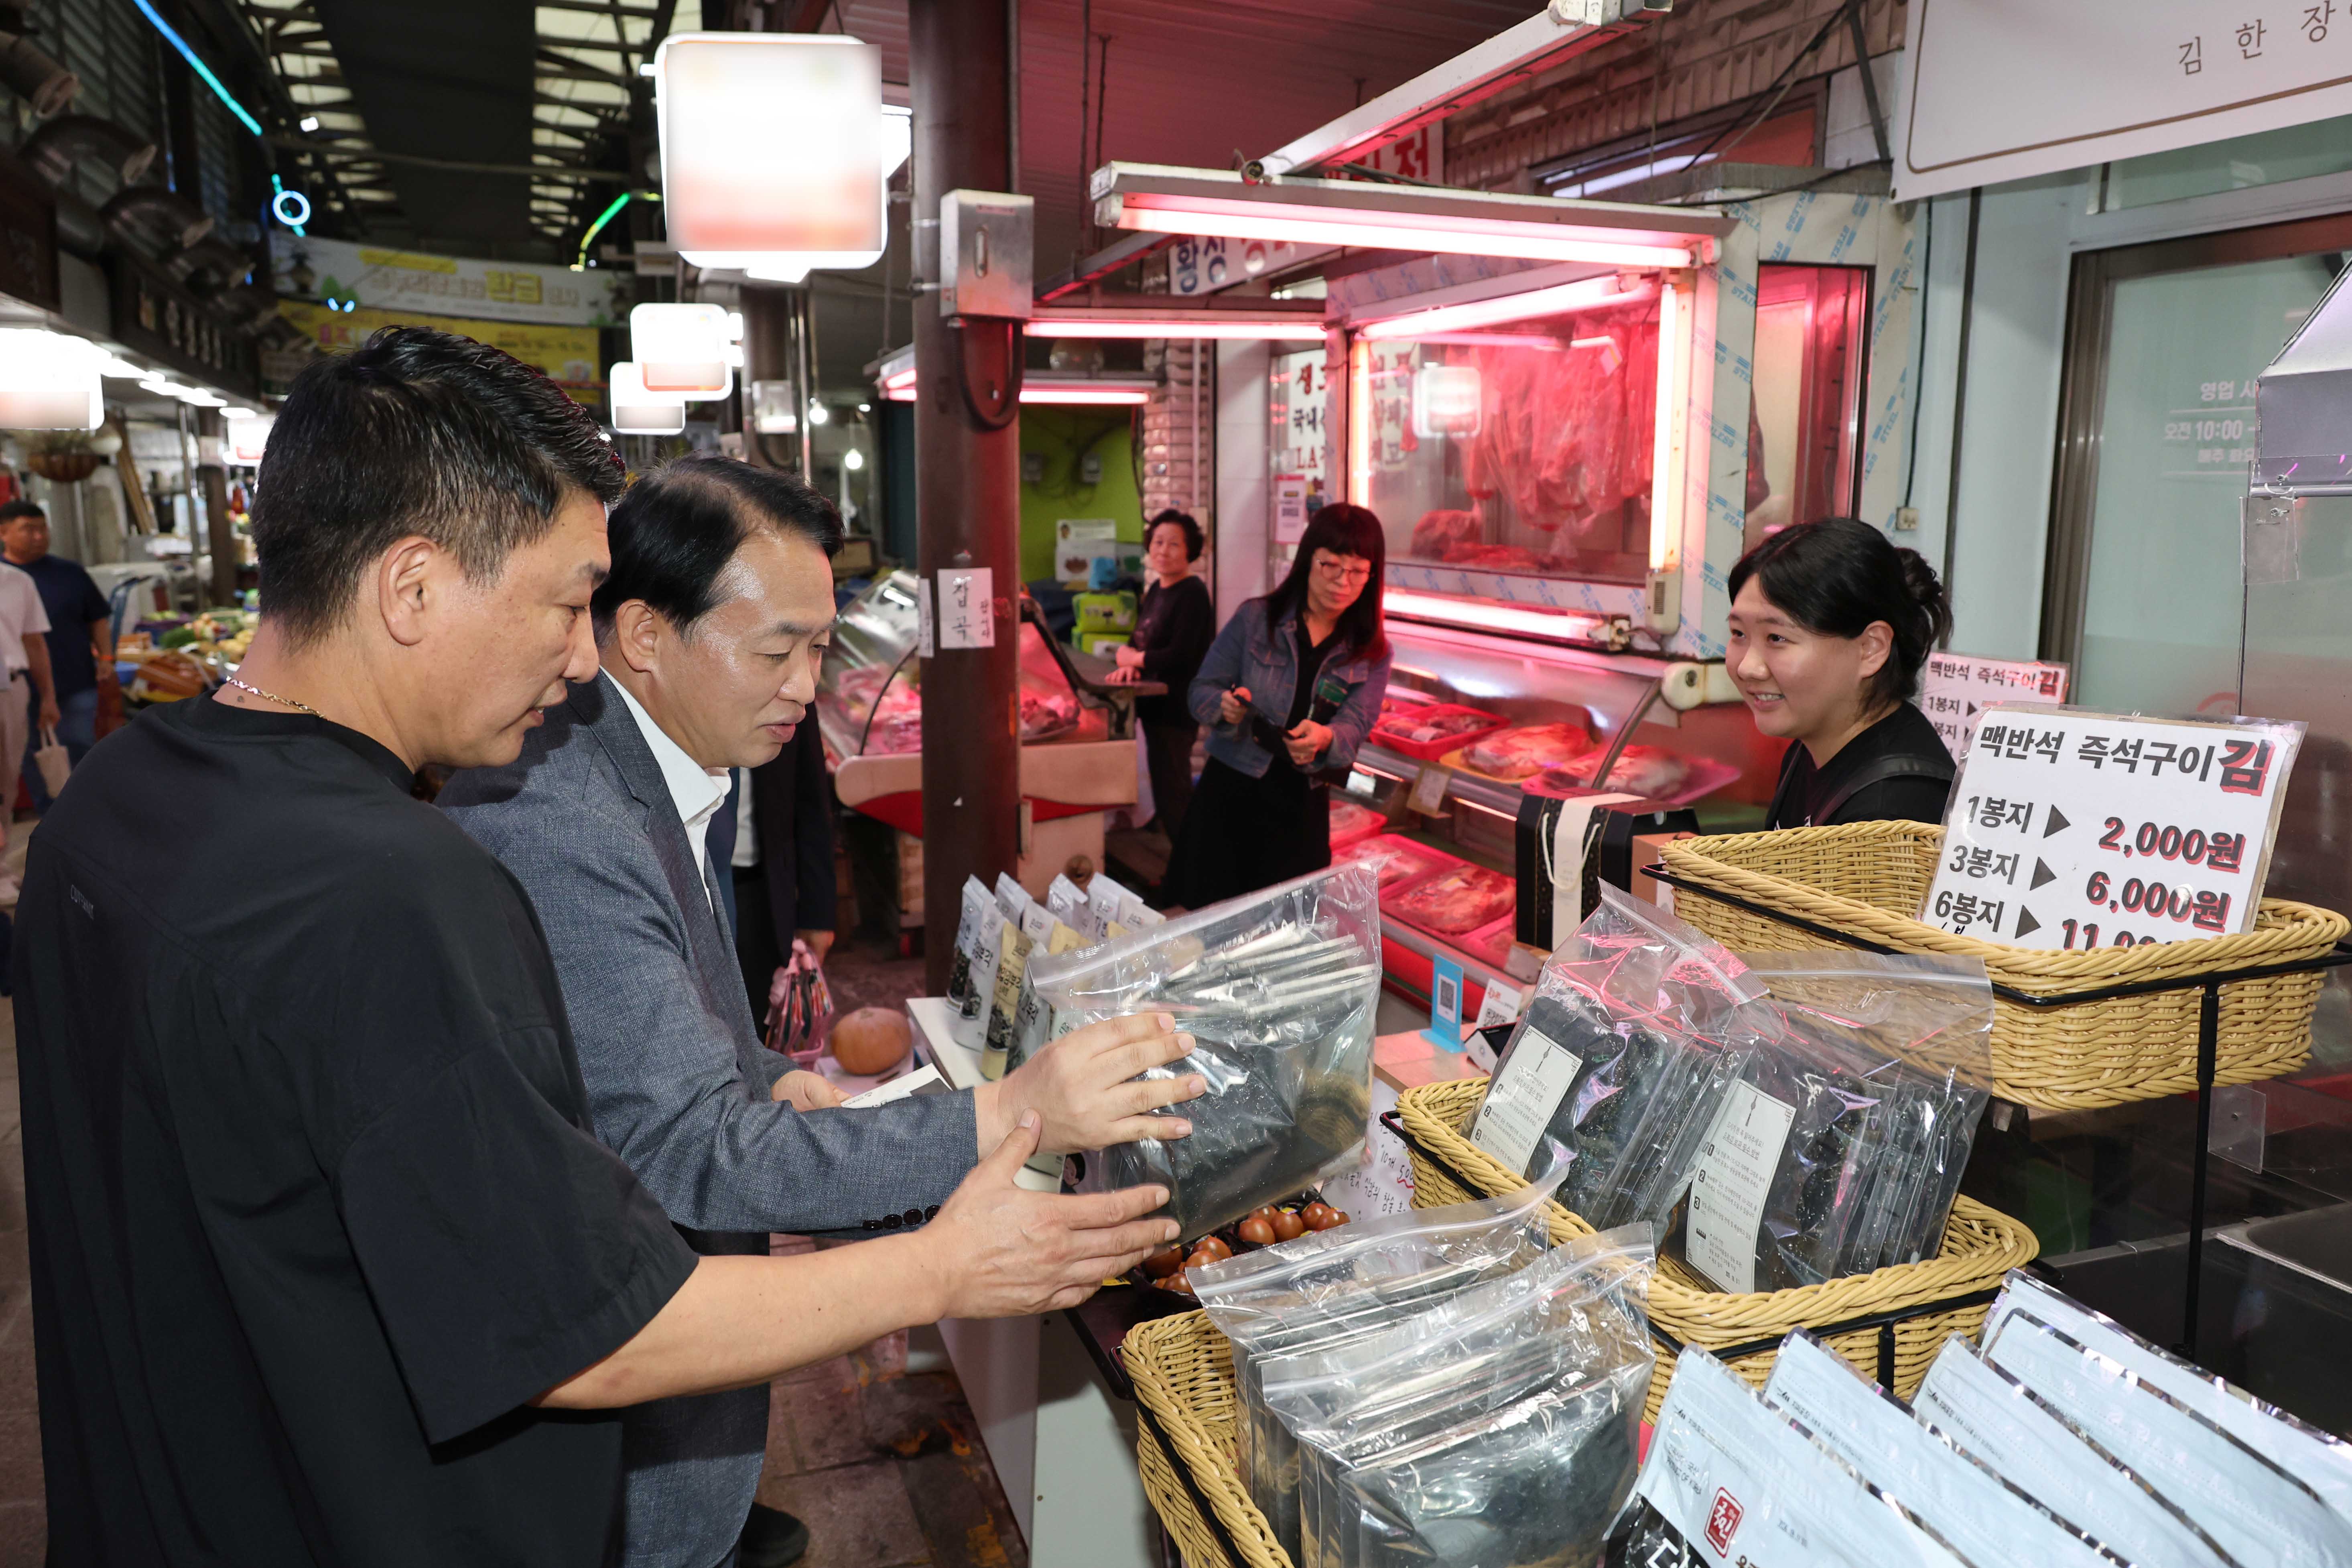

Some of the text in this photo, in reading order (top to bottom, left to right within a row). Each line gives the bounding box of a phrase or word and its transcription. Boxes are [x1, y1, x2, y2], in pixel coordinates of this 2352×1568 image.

[2179, 0, 2336, 75] 김 한 장
[2200, 381, 2235, 401] 영업
[1293, 404, 1326, 434] 국내
[2196, 419, 2243, 441] 10:00
[1930, 661, 1970, 681] 맥반석
[1928, 697, 1960, 715] 1봉지
[1934, 722, 1958, 740] 봉지
[1980, 725, 2066, 764] 맥반석
[1968, 796, 2246, 874] 1봉지 2,000원
[1949, 845, 2232, 933] 3봉지 6,000원
[1935, 890, 2005, 933] 6봉지
[1485, 1106, 1491, 1117] 2
[1476, 1129, 1481, 1140] 3
[1381, 1150, 1396, 1169] 10개
[1700, 1170, 1705, 1182] 2
[1694, 1197, 1699, 1209] 3
